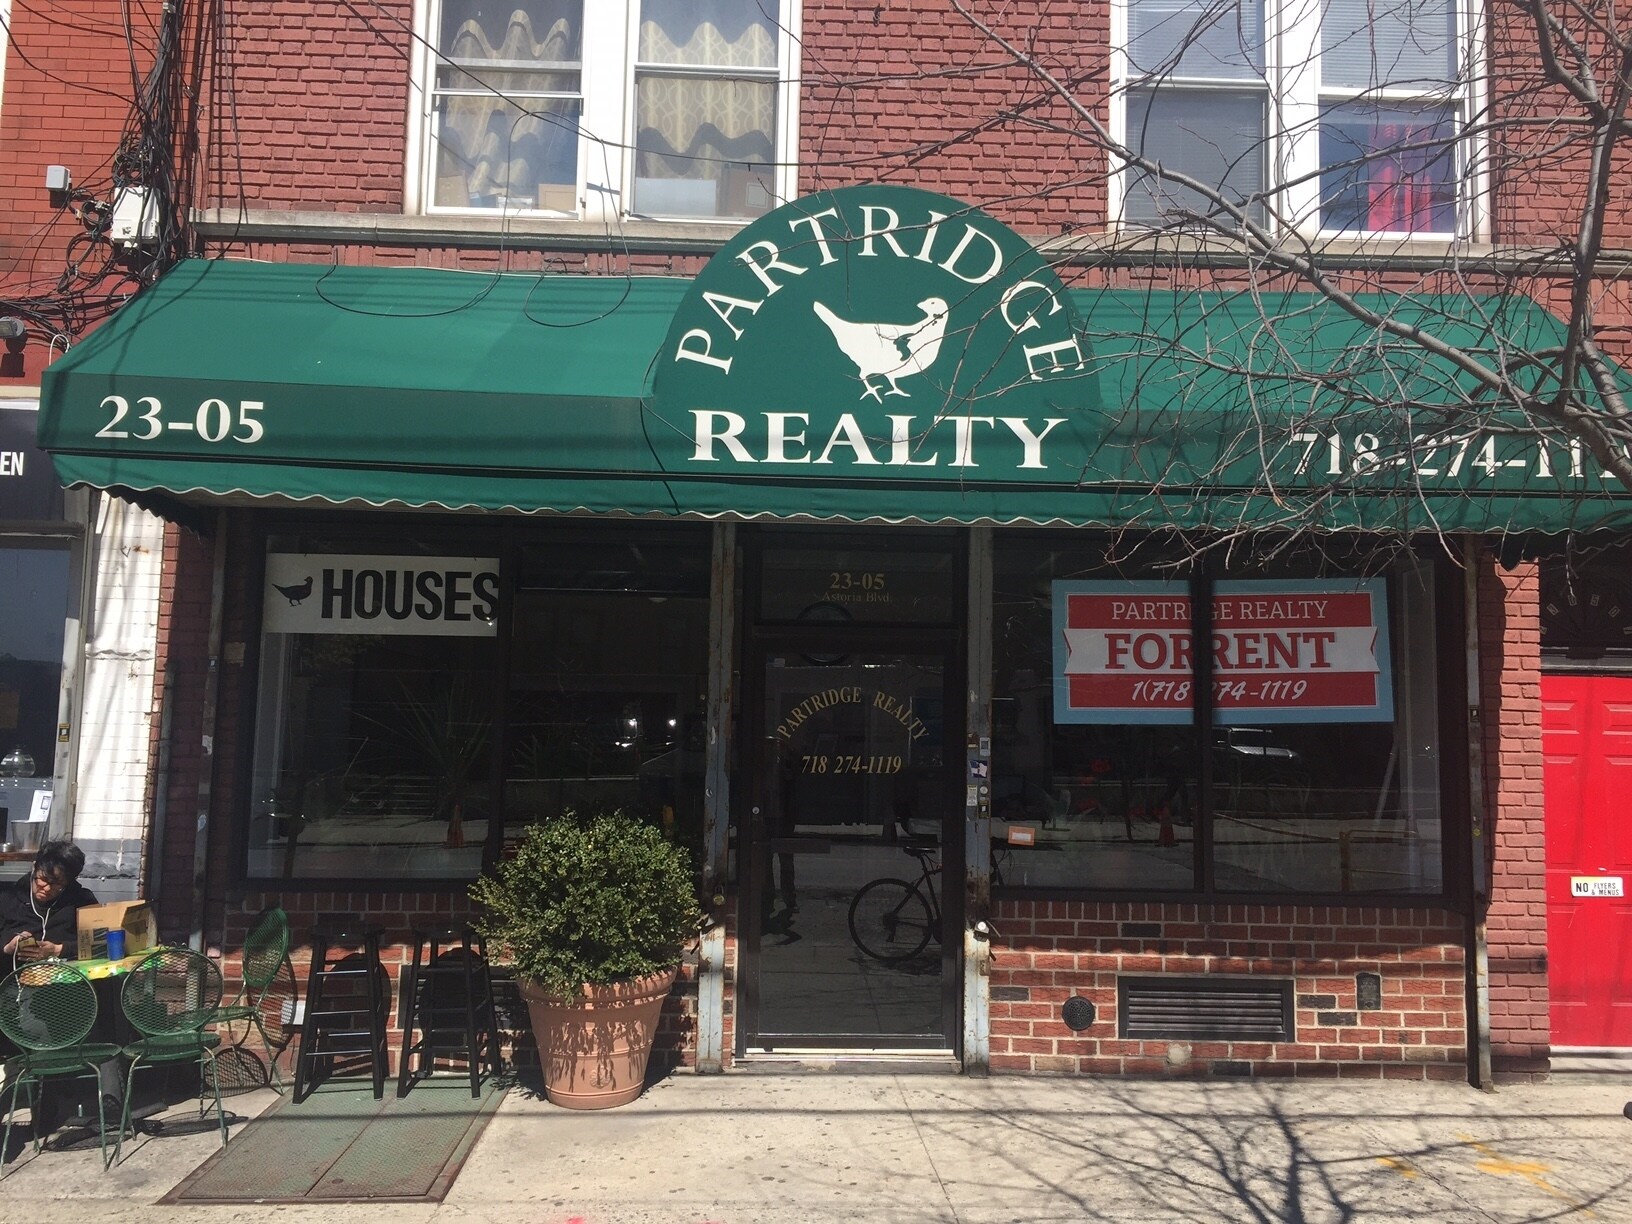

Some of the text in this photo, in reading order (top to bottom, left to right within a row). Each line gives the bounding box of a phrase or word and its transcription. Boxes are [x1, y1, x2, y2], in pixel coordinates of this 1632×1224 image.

[675, 205, 1085, 381] PARTRIDGE
[95, 395, 266, 443] 23-05
[687, 410, 1069, 470] REALTY
[0, 451, 25, 476] EN
[1289, 432, 1632, 479] 718-274-11
[829, 572, 885, 590] 23-05
[321, 569, 499, 621] HOUSES
[822, 592, 862, 602] Astoria
[1111, 600, 1328, 621] PARTRIGE REALTY
[776, 686, 930, 741] PARTRIDGE REALTY
[801, 755, 903, 774] 718 274-1119
[1575, 882, 1589, 893] NO
[1593, 882, 1616, 890] FLYERS
